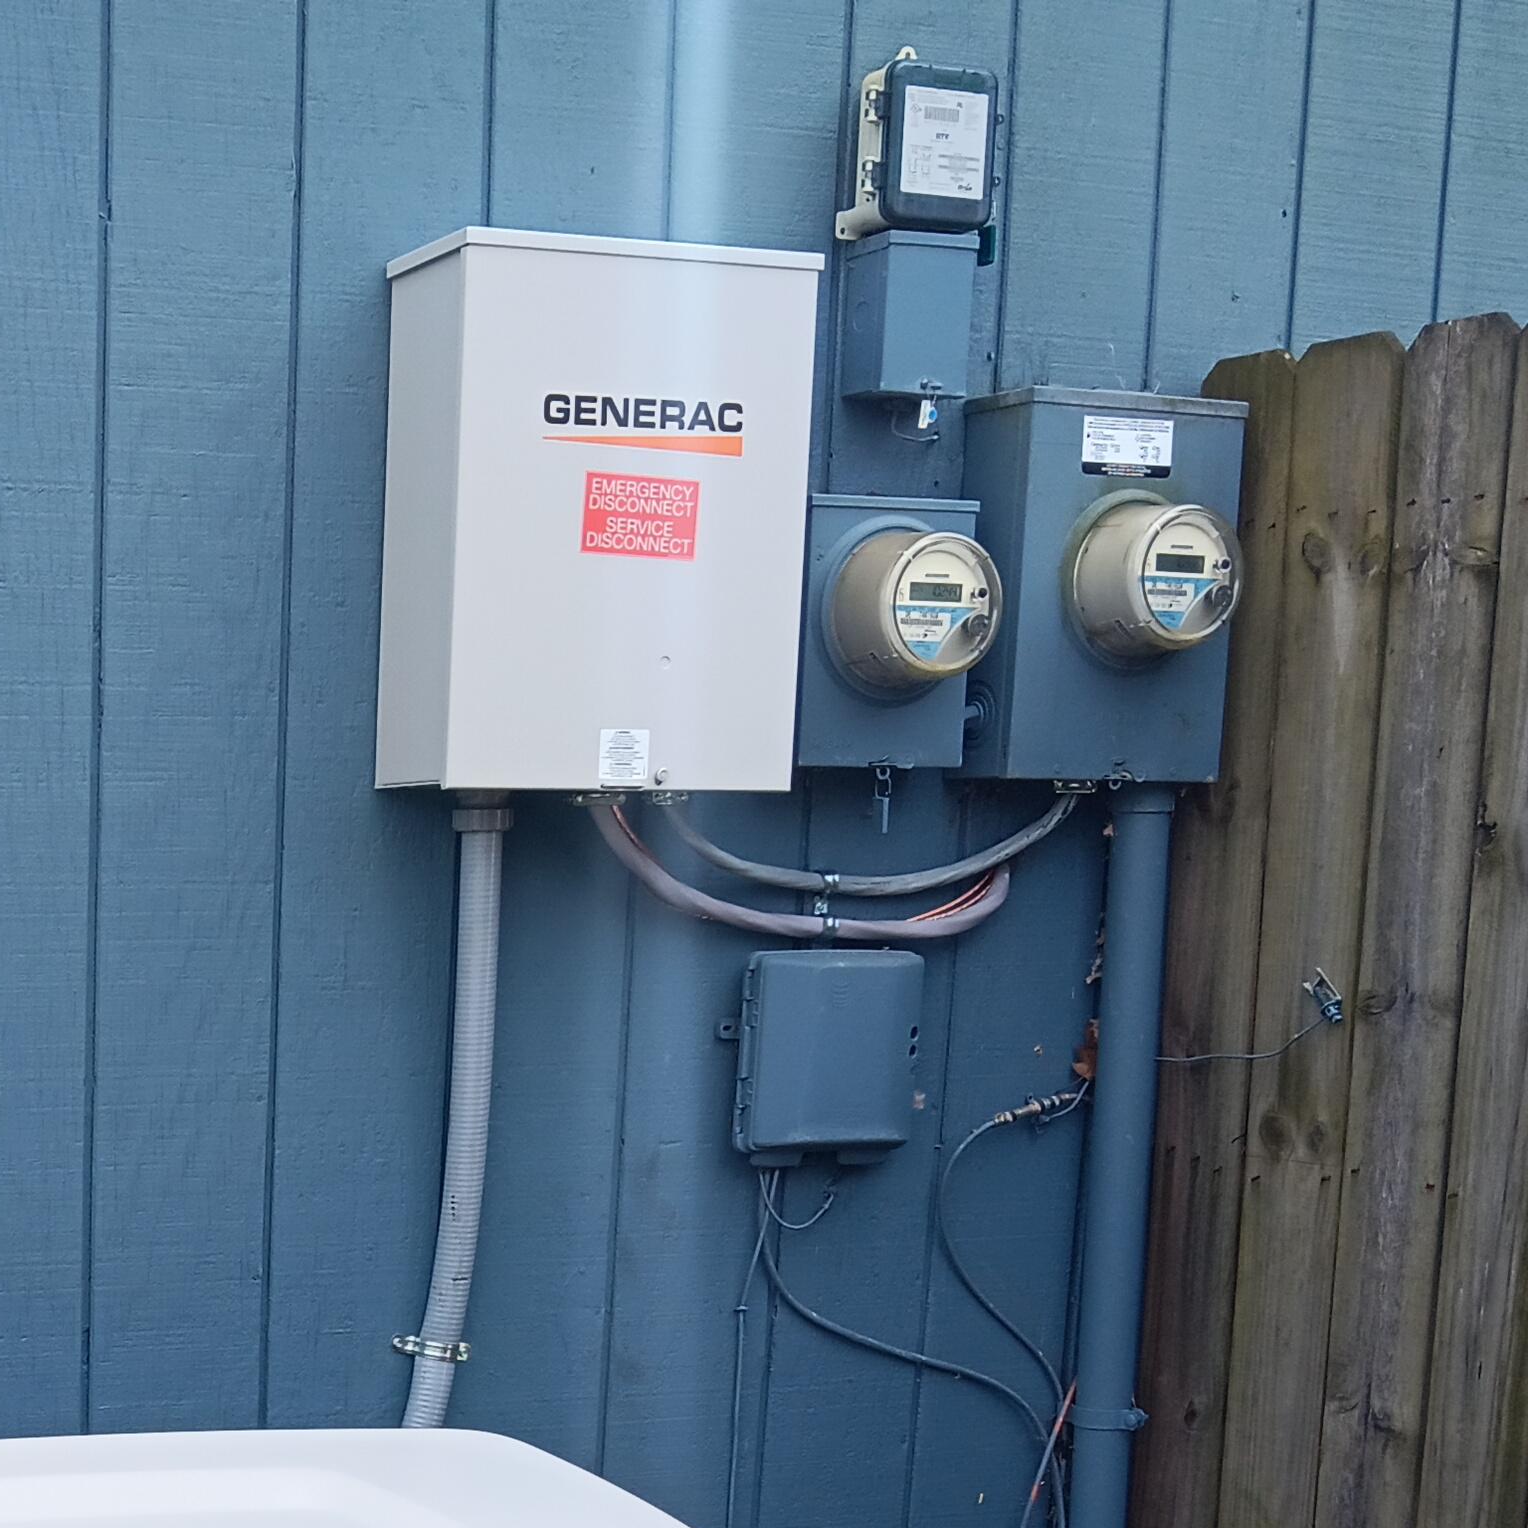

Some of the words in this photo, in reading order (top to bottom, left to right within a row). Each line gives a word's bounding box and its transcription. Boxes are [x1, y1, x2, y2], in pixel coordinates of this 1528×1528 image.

[543, 393, 743, 433] GENERAC
[592, 478, 694, 500] EMERGENCY
[588, 495, 694, 517] DISCONNECT
[606, 517, 673, 537] SERVICE
[586, 532, 692, 554] DISCONNECT
